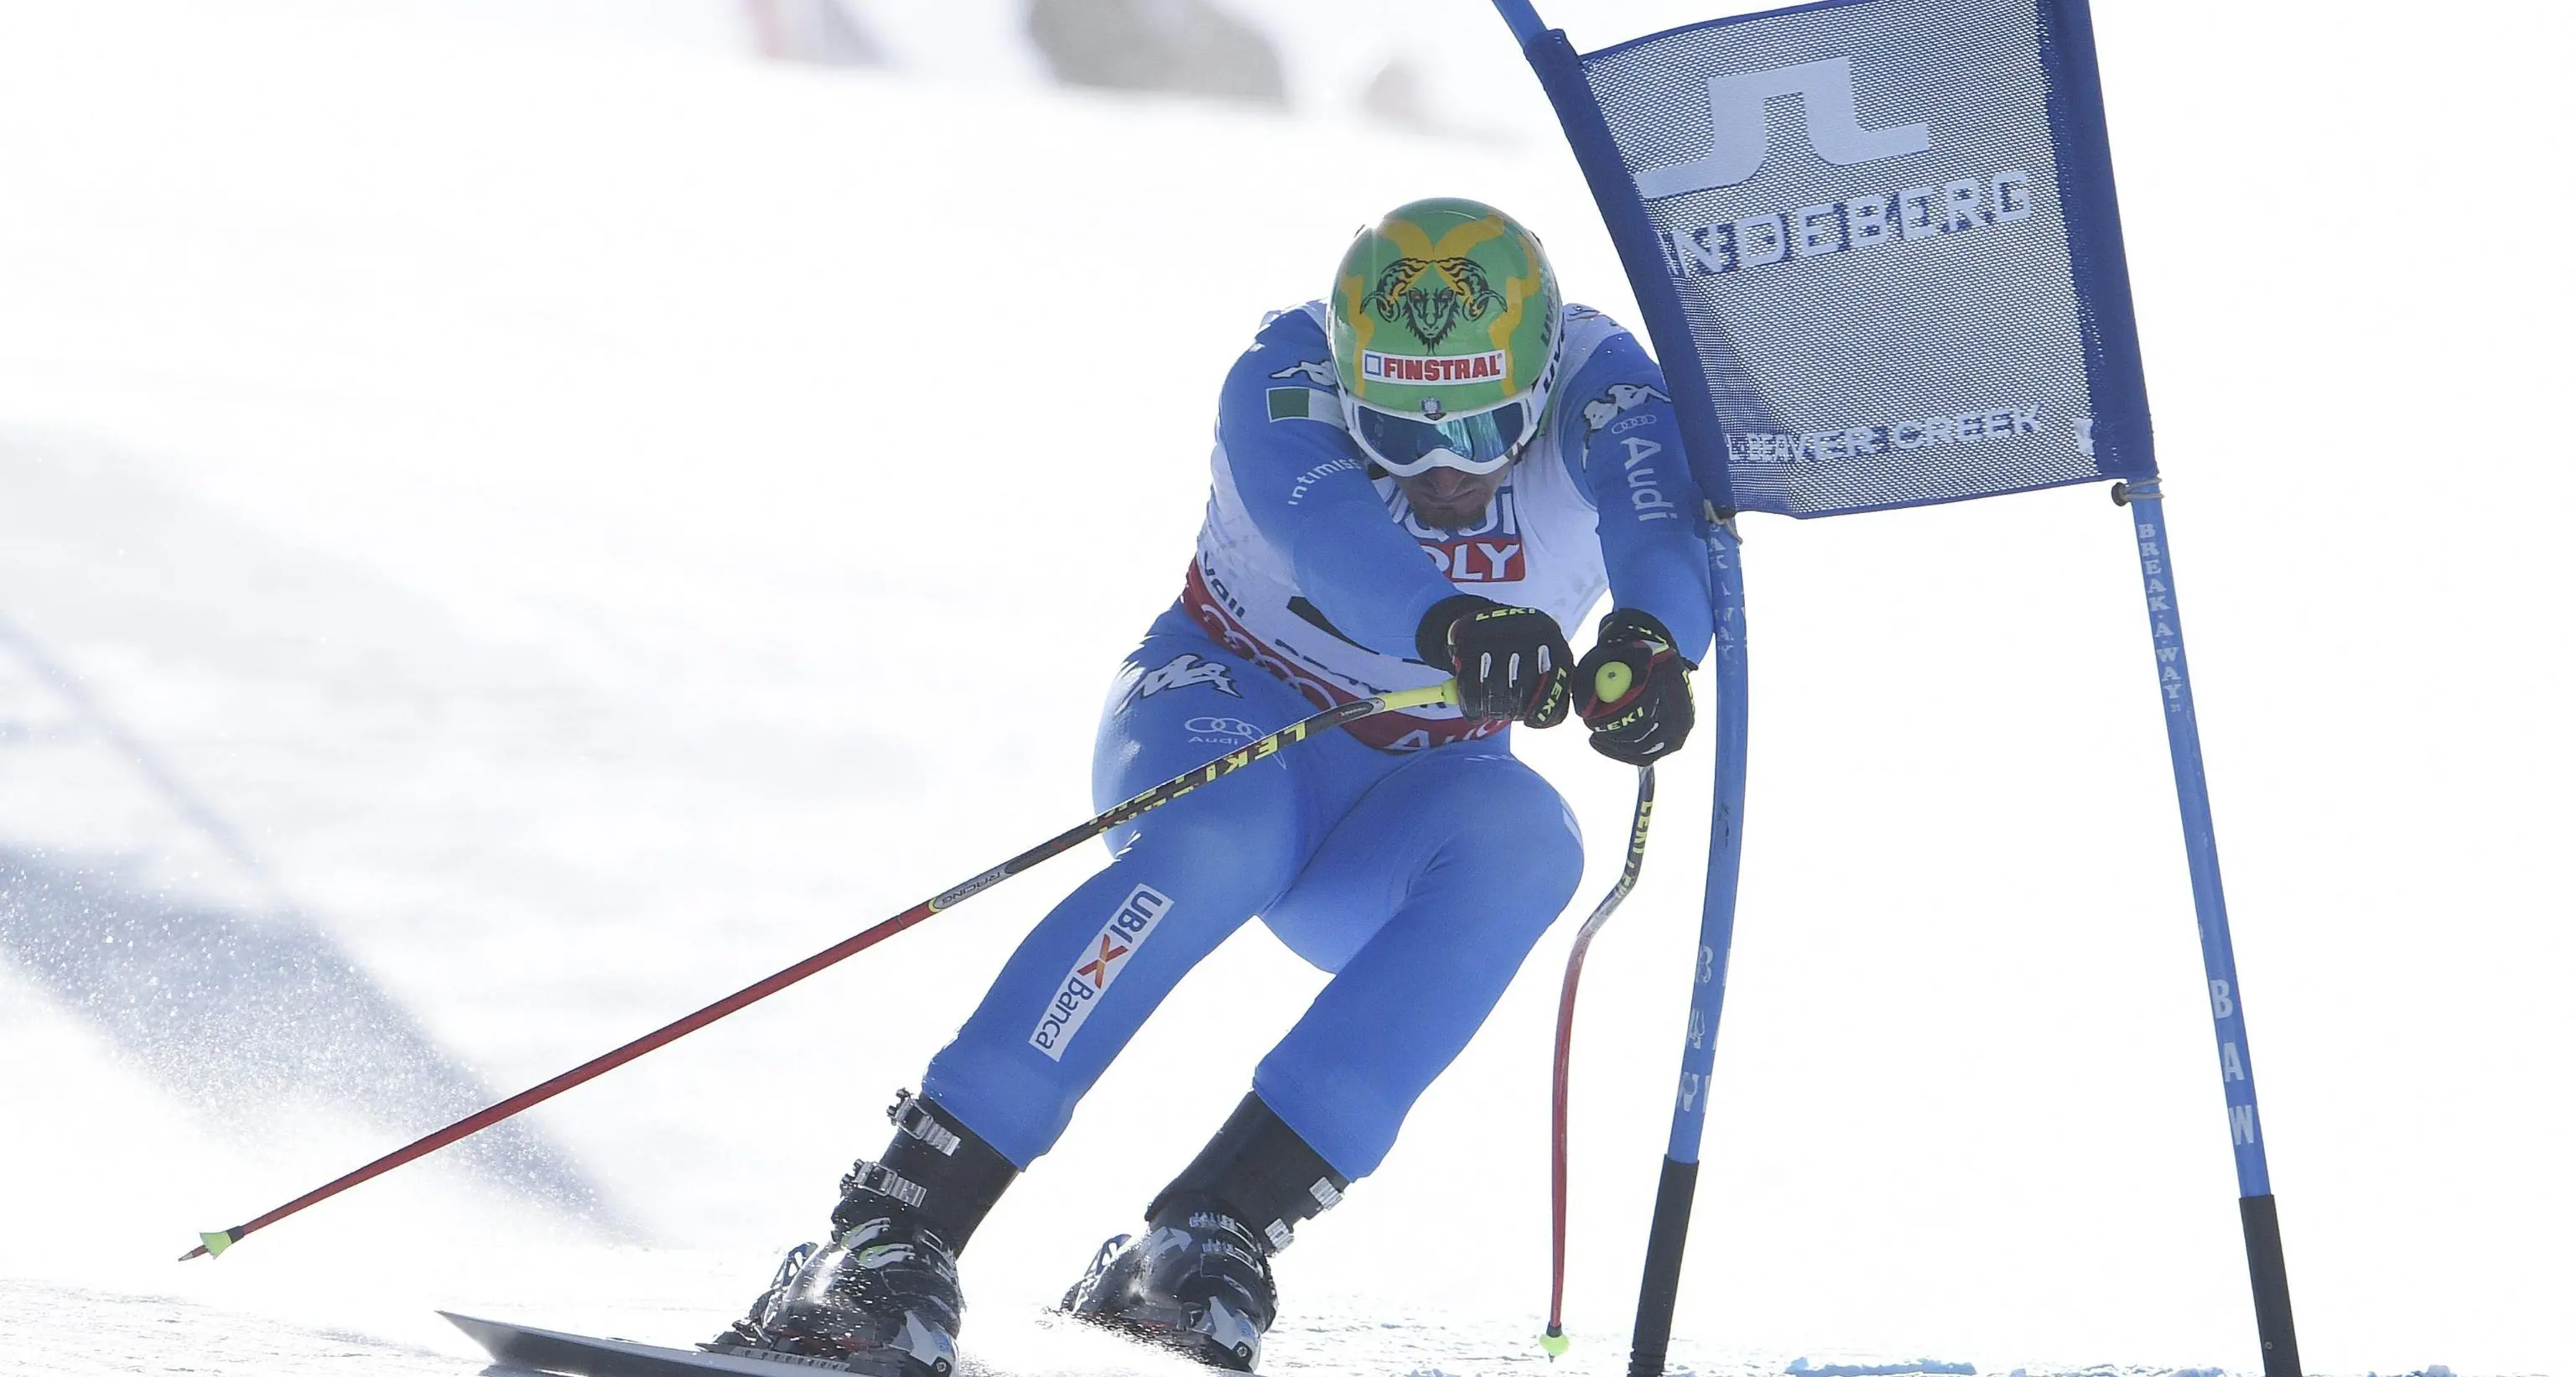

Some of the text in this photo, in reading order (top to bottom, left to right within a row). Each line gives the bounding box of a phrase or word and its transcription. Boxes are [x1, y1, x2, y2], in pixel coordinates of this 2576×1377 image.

[1384, 355, 1500, 382] FINSTRAL
[1893, 403, 2043, 449] CREEK
[1619, 436, 1678, 522] Audi
[1476, 607, 1536, 621] LEKI
[1537, 667, 1566, 722] LEKI
[1187, 735, 1238, 746] Audi
[1594, 707, 1644, 733] LEKI
[1206, 720, 1306, 782] LEKI
[1036, 977, 1094, 1050] Banca
